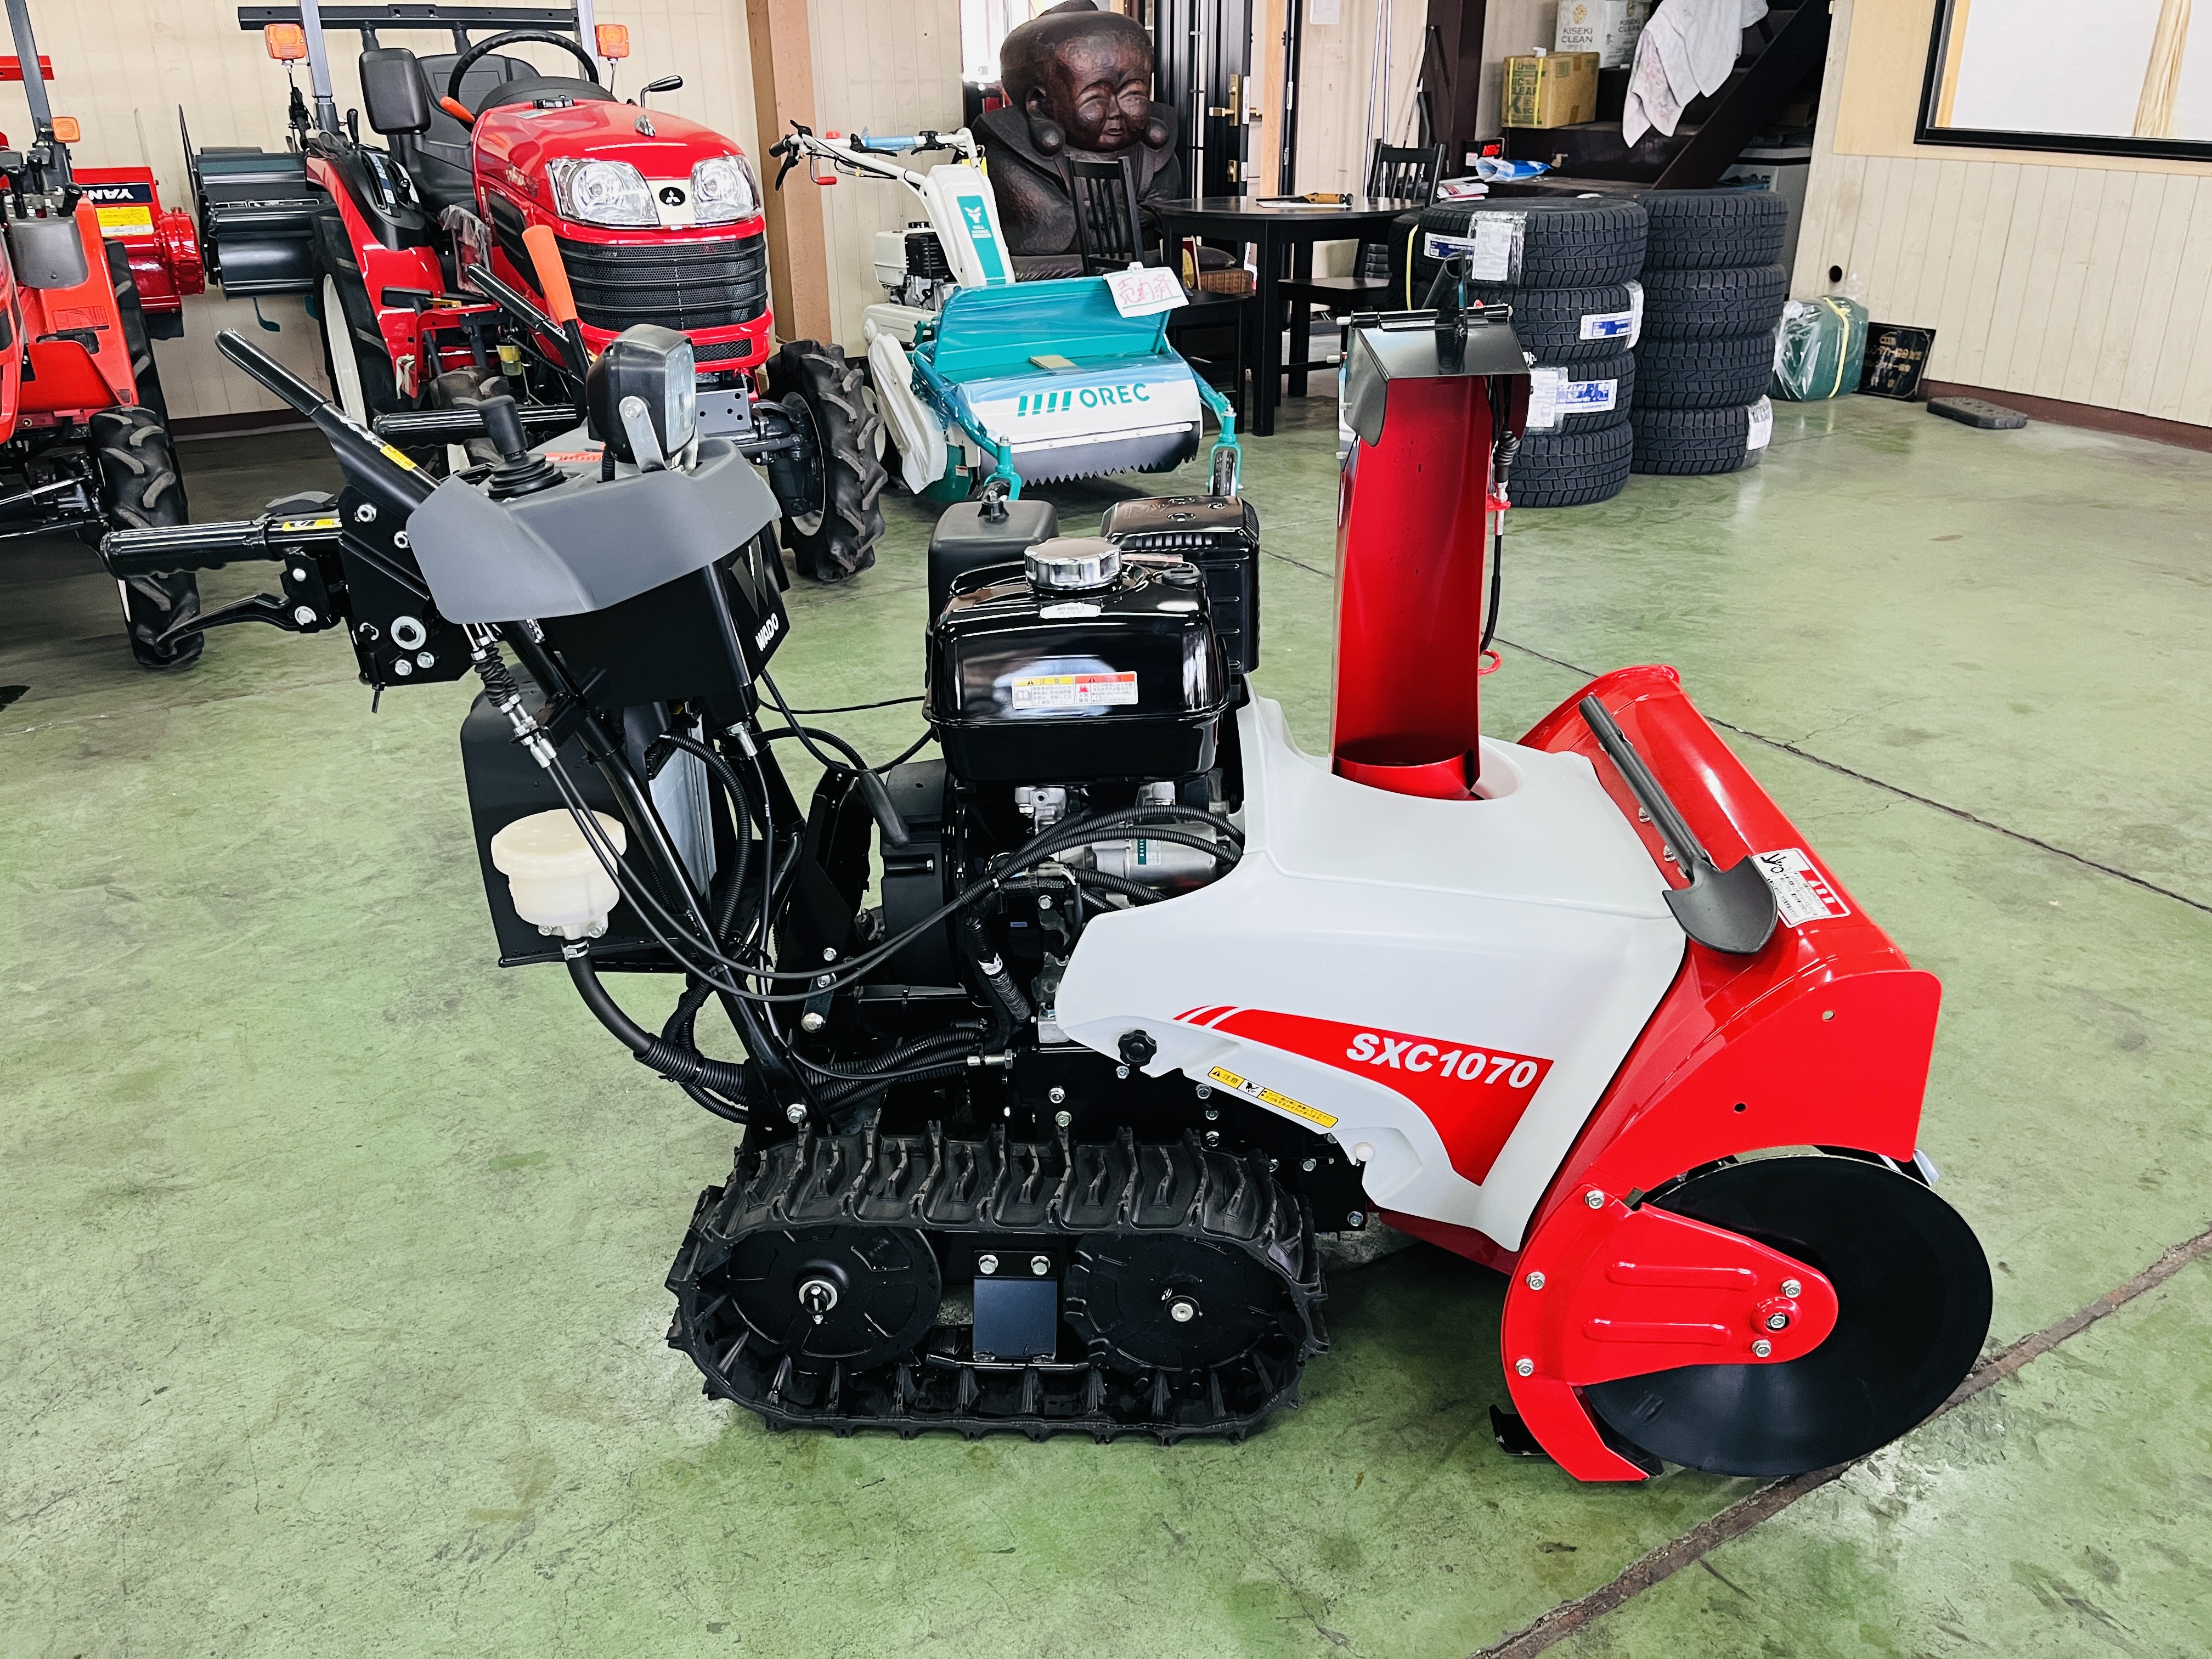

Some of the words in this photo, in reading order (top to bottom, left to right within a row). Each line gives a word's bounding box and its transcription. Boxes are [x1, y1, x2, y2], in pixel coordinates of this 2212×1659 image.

[82, 188, 134, 200] YAN
[1079, 383, 1150, 408] OREC
[755, 612, 779, 652] WADO
[1346, 1033, 1538, 1088] SXC1070
